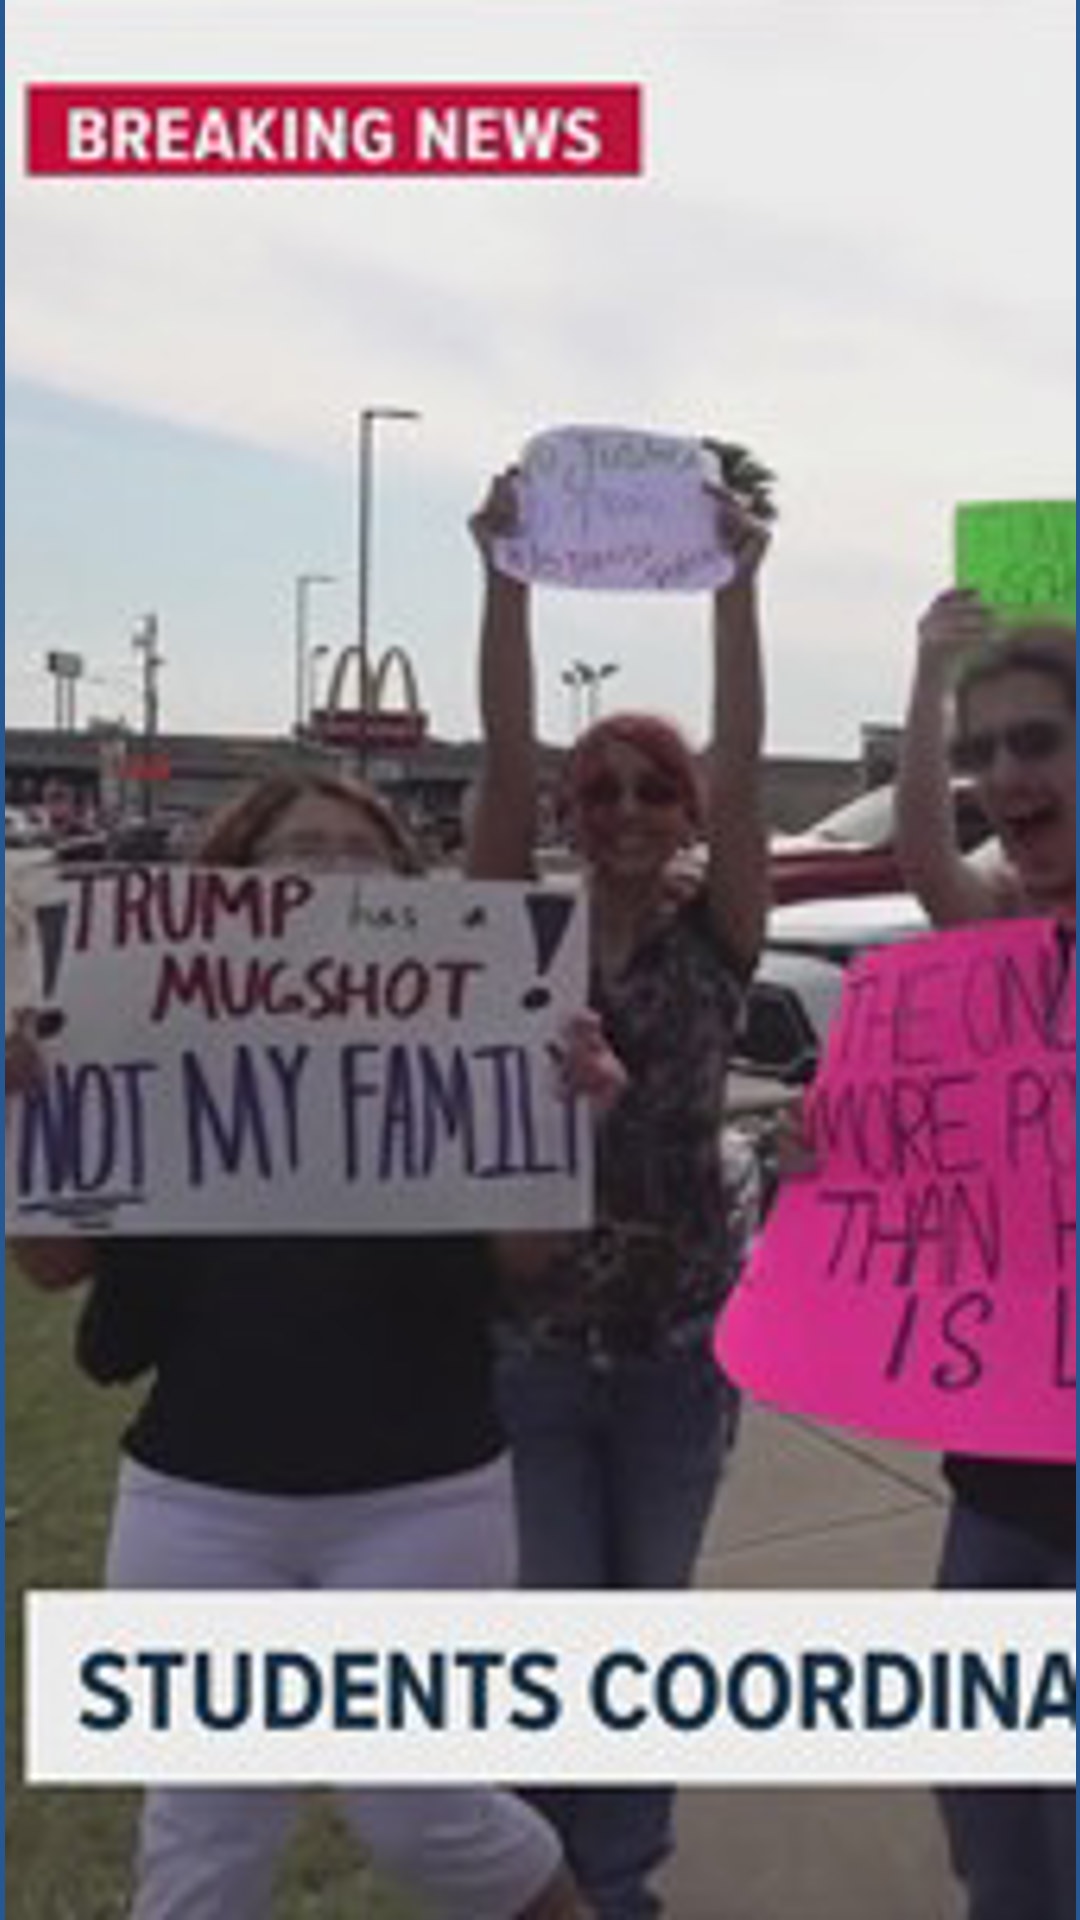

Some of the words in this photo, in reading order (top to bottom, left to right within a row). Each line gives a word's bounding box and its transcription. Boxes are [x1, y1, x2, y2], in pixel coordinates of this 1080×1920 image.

[60, 866, 314, 952] TRUMP
[350, 880, 418, 929] has
[151, 953, 486, 1021] MUGSHOT
[840, 960, 948, 1066] THE
[18, 1060, 158, 1196] NOT
[182, 1044, 310, 1187] MY
[808, 1068, 981, 1180] MORE
[820, 1178, 1001, 1287] THAN
[885, 1289, 994, 1390] IS
